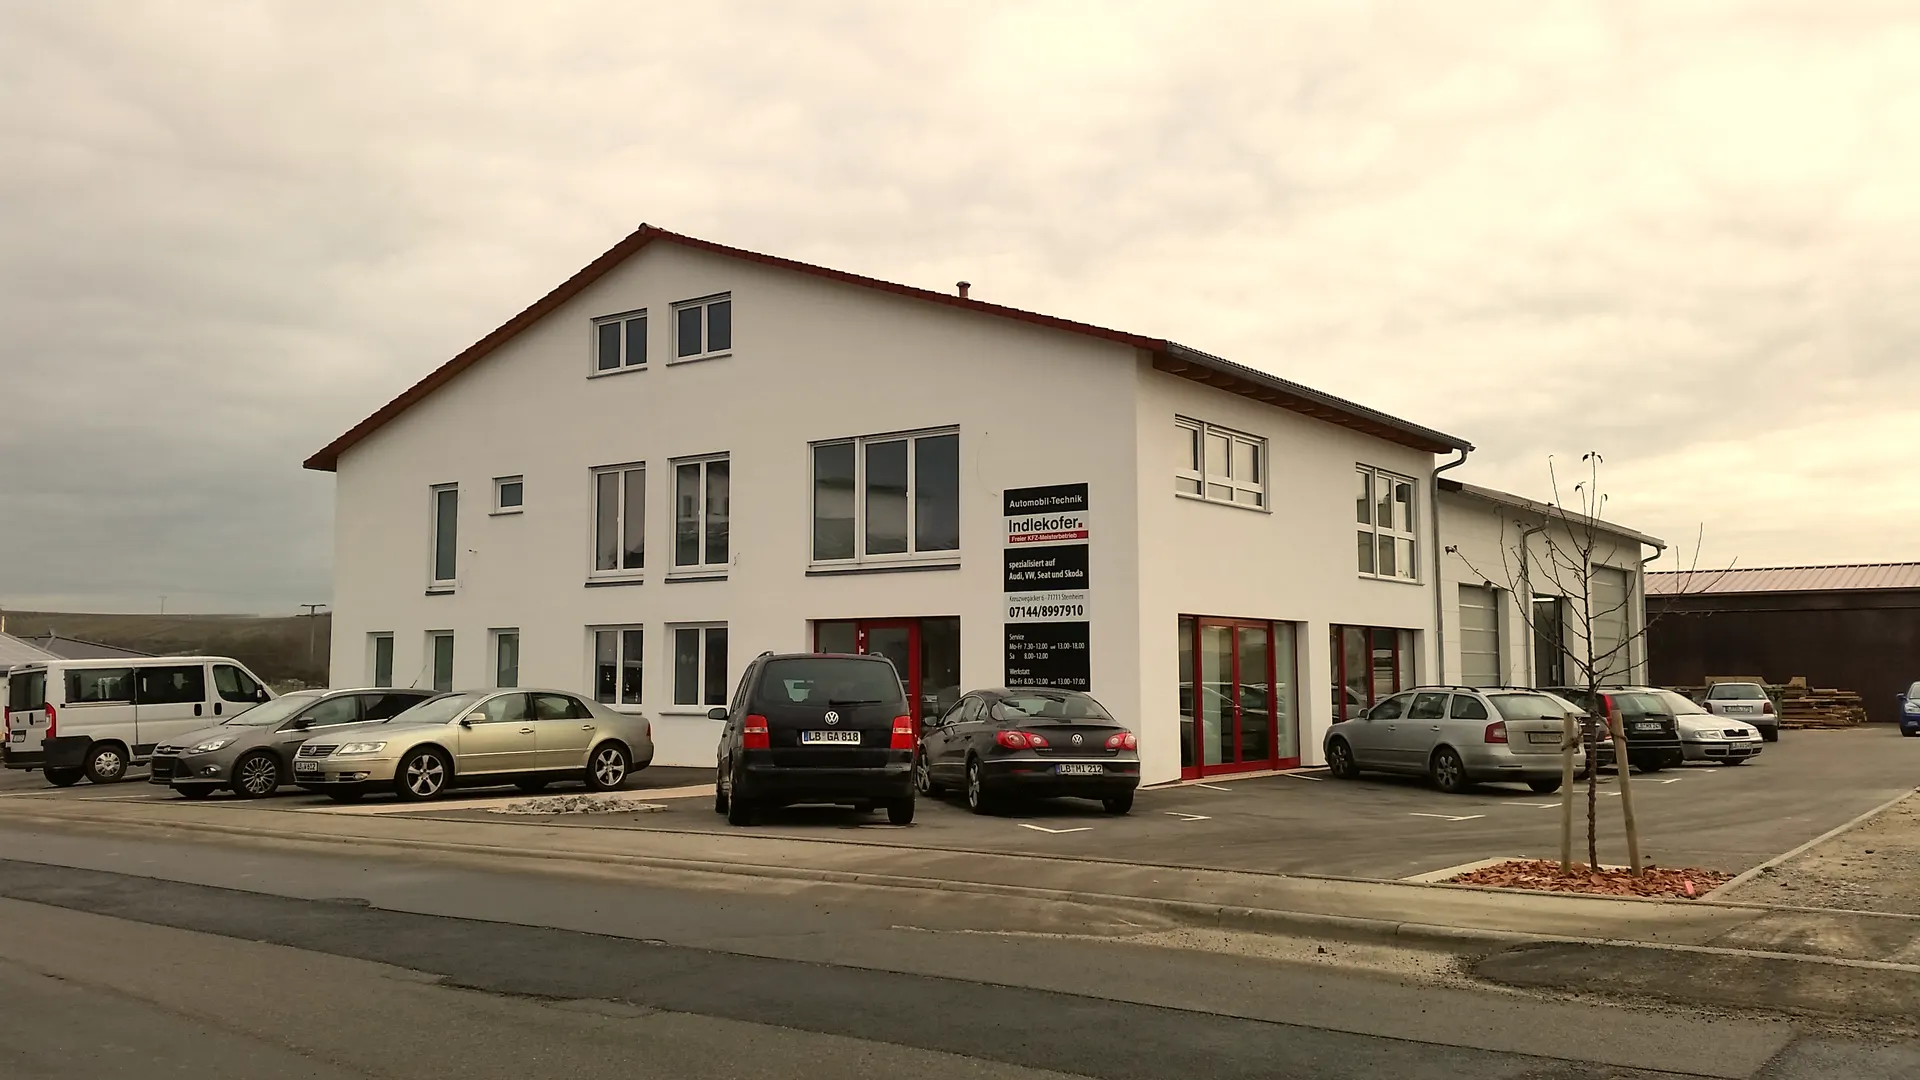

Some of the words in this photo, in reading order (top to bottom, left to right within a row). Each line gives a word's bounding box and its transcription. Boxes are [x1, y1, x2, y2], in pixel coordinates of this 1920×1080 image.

[1008, 559, 1044, 570] spezialisiert
[1045, 558, 1056, 567] auf
[1008, 572, 1024, 580] Audi,
[1037, 571, 1051, 579] Seat
[1051, 570, 1064, 578] und
[1009, 605, 1084, 618] 07144/8997910
[809, 732, 821, 741] LB
[827, 732, 839, 741] GA
[841, 732, 859, 742] 818
[1060, 764, 1072, 773] LB
[1088, 764, 1102, 773] 212
